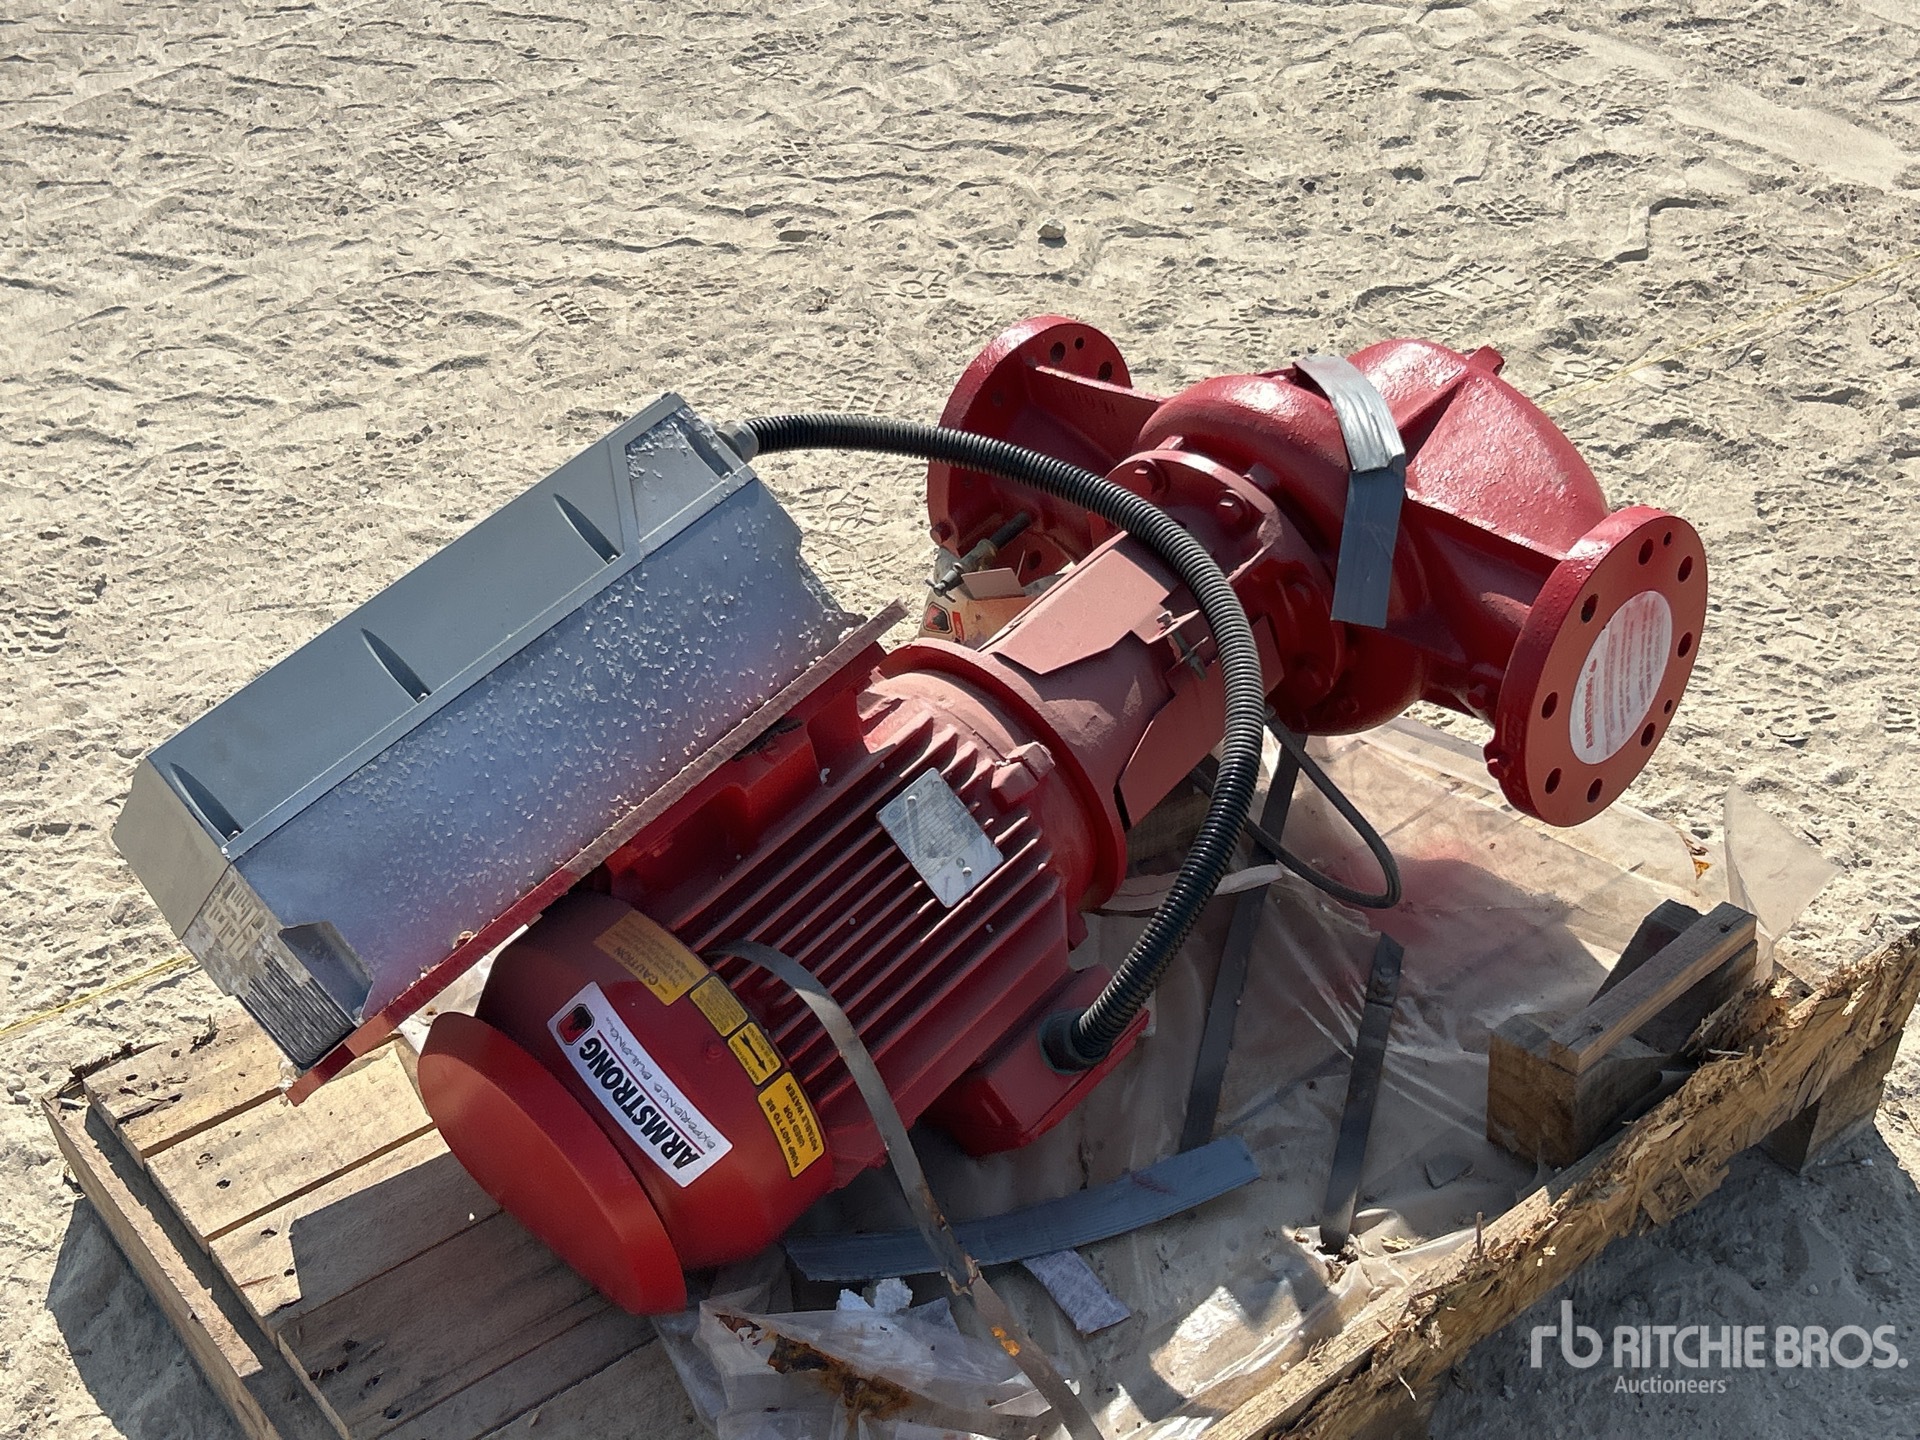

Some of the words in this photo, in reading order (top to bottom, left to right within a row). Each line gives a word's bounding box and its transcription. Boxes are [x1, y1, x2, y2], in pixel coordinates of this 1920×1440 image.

[577, 1034, 700, 1168] ARMSTRONG
[765, 1097, 776, 1112] BE
[785, 1082, 804, 1115] WATER
[772, 1112, 782, 1126] TO
[782, 1104, 795, 1124] FOR
[779, 1126, 791, 1144] NOT
[791, 1124, 805, 1147] USED
[800, 1114, 818, 1151] POTABLE
[787, 1145, 799, 1167] PUMP
